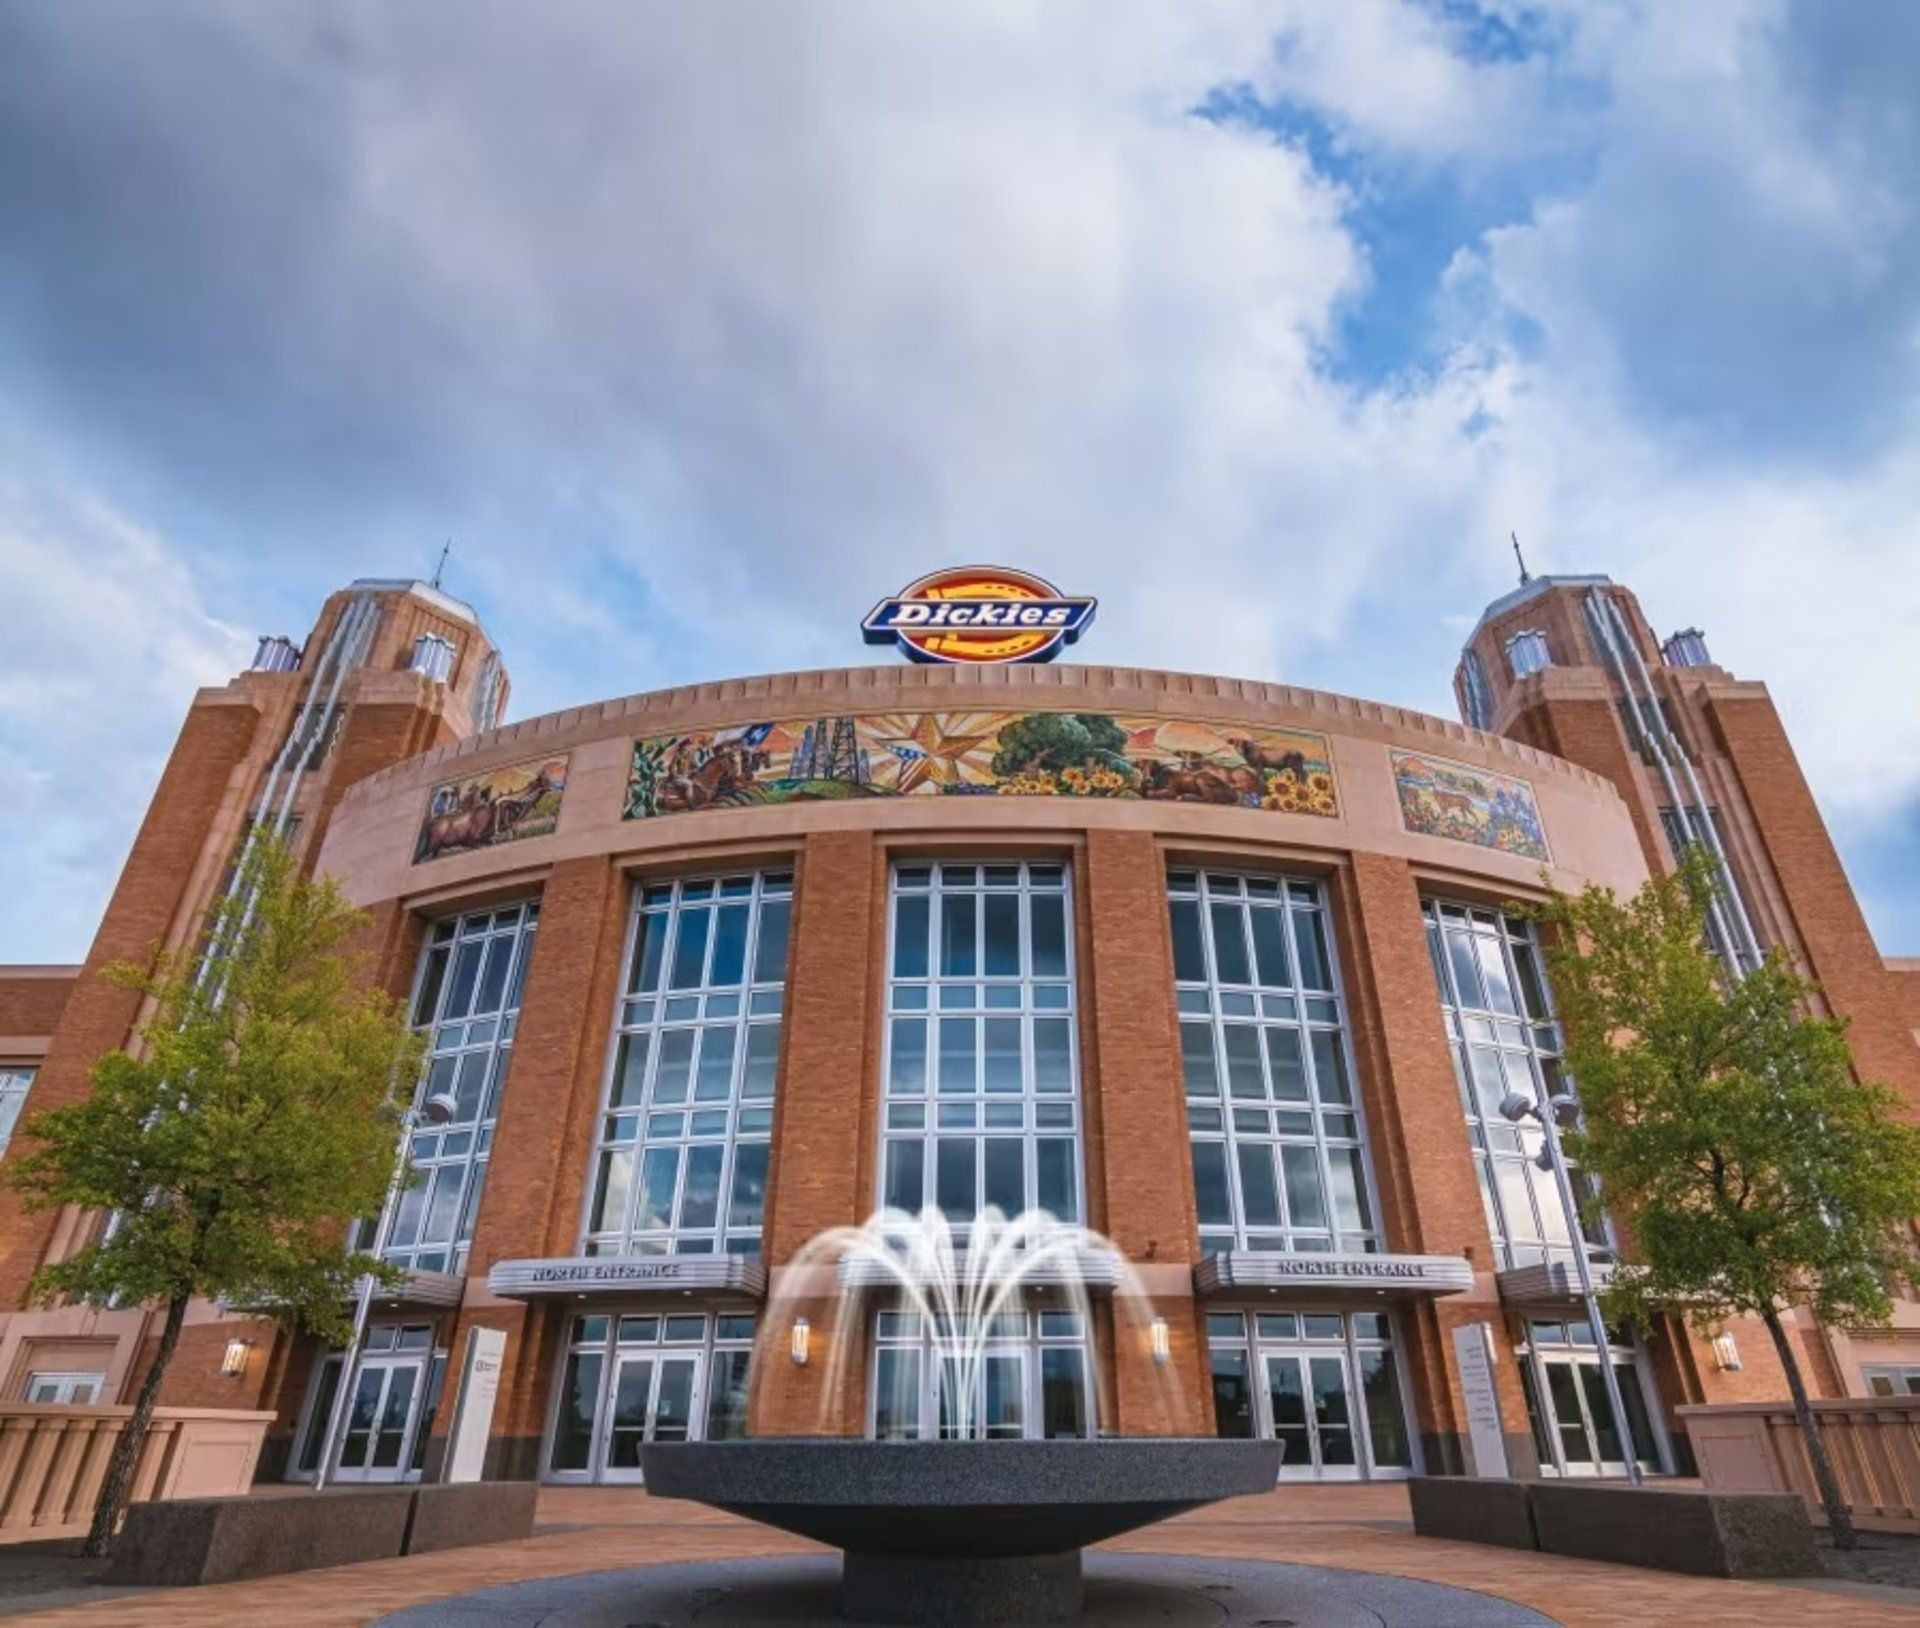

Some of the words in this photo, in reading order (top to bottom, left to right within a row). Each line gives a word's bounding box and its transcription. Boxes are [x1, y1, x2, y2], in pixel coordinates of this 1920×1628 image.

[888, 604, 1071, 625] Dickies
[532, 1265, 589, 1282] NORTH
[595, 1263, 681, 1279] ENTRANCE
[1279, 1260, 1338, 1275] NORTH
[1343, 1261, 1425, 1277] ENTRANCE
